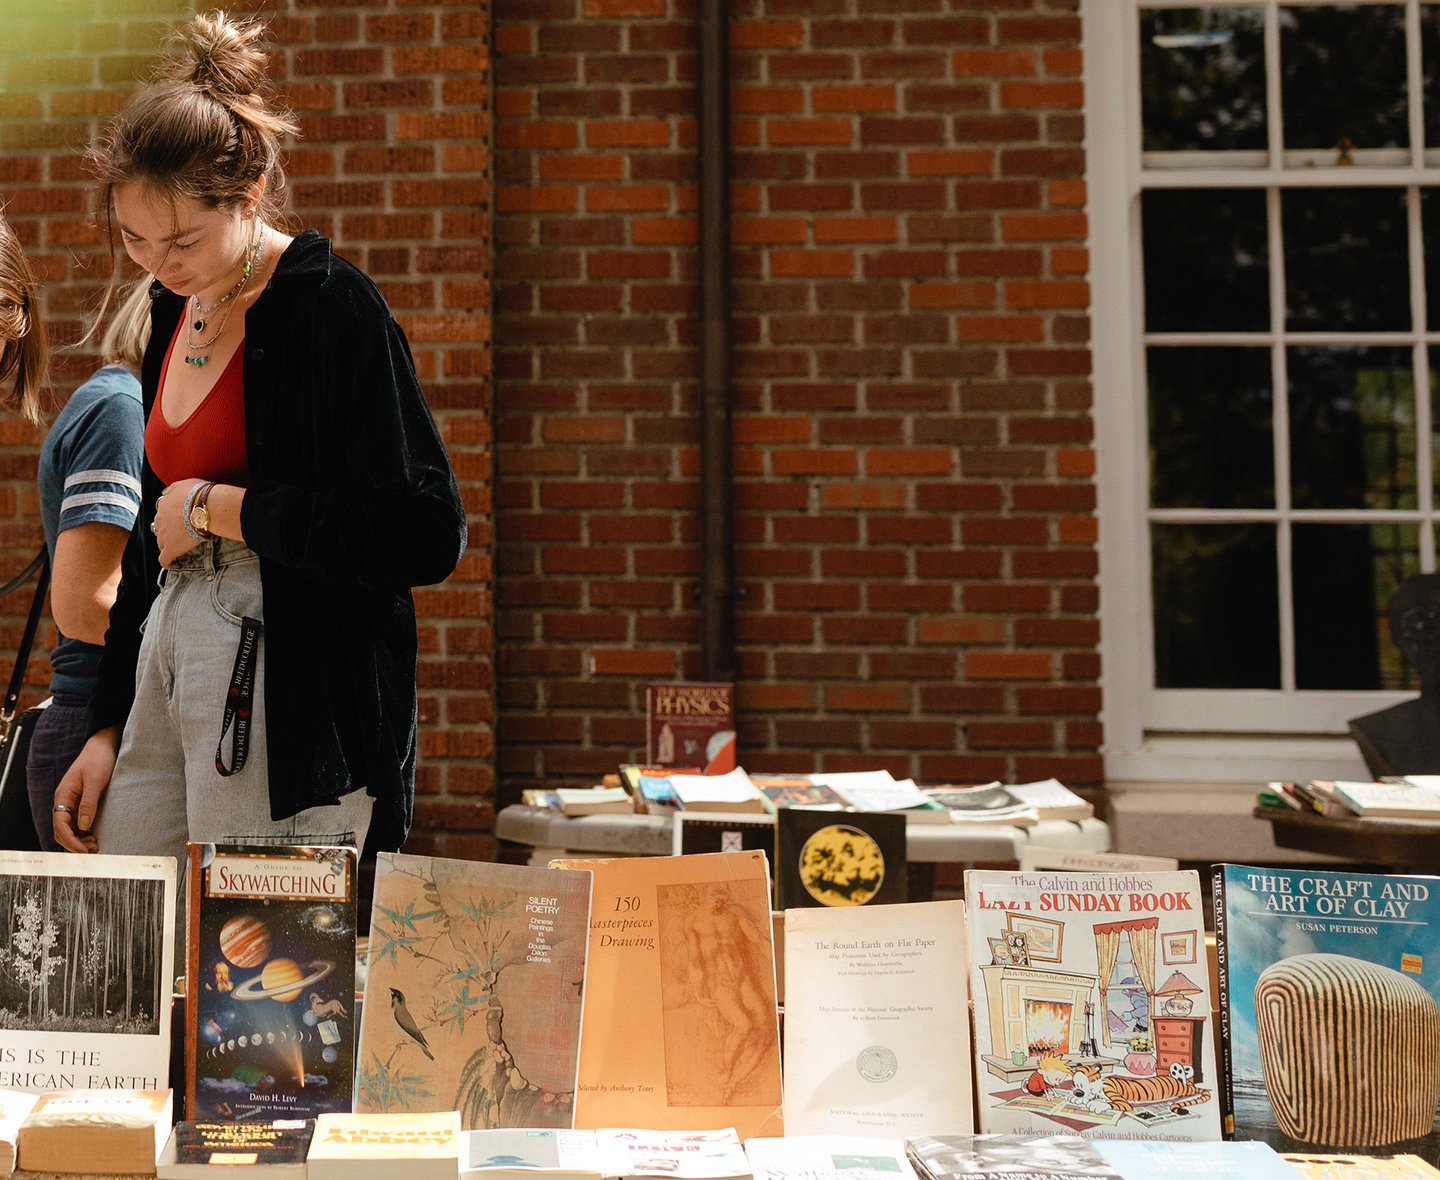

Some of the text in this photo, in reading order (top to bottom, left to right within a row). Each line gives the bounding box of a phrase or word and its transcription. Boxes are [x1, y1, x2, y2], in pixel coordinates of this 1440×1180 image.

[656, 696, 731, 715] PHYSICS
[219, 866, 336, 895] SKYWATCHING
[1011, 876, 1153, 892] The Calvin and Hobbes
[1214, 873, 1222, 897] THE
[1247, 874, 1429, 902] THE CRAFT AND
[528, 897, 558, 906] SILENT
[614, 896, 641, 912] 150
[1040, 893, 1127, 912] SUNDAY
[1128, 892, 1193, 911] BOOK
[1265, 894, 1410, 919] ART OF CLAY
[526, 905, 560, 915] POETRY
[1215, 899, 1224, 935] CRAFT
[528, 924, 554, 932] Paintings
[530, 917, 553, 925] Chinese
[590, 917, 654, 932] asterpieces
[1295, 922, 1378, 935] SUSAN PETERSON
[600, 935, 655, 950] Drawing
[815, 942, 829, 950] The
[833, 941, 858, 950] Round
[861, 940, 881, 949] Earth
[898, 939, 912, 947] Flat
[915, 938, 935, 948] Paper
[1217, 939, 1225, 963] AND
[526, 955, 551, 963] Galleries
[1218, 967, 1227, 989] ART
[1220, 992, 1228, 1008] OF
[1221, 1011, 1229, 1040] CLAY
[28, 1049, 45, 1064] IS
[56, 1050, 101, 1067] THE
[88, 1075, 158, 1090] EARTH
[601, 1084, 607, 1093] by
[610, 1085, 635, 1094] Anthony
[249, 1092, 298, 1103] DAVID H. LEVY
[328, 1128, 453, 1136] Edward
[1065, 1130, 1092, 1139] Sunday
[1093, 1130, 1115, 1139] Calvin
[1117, 1132, 1130, 1140] and
[1132, 1132, 1158, 1141] Hobbes
[1160, 1133, 1192, 1142] Cartoons
[321, 1134, 453, 1146] Abbey
